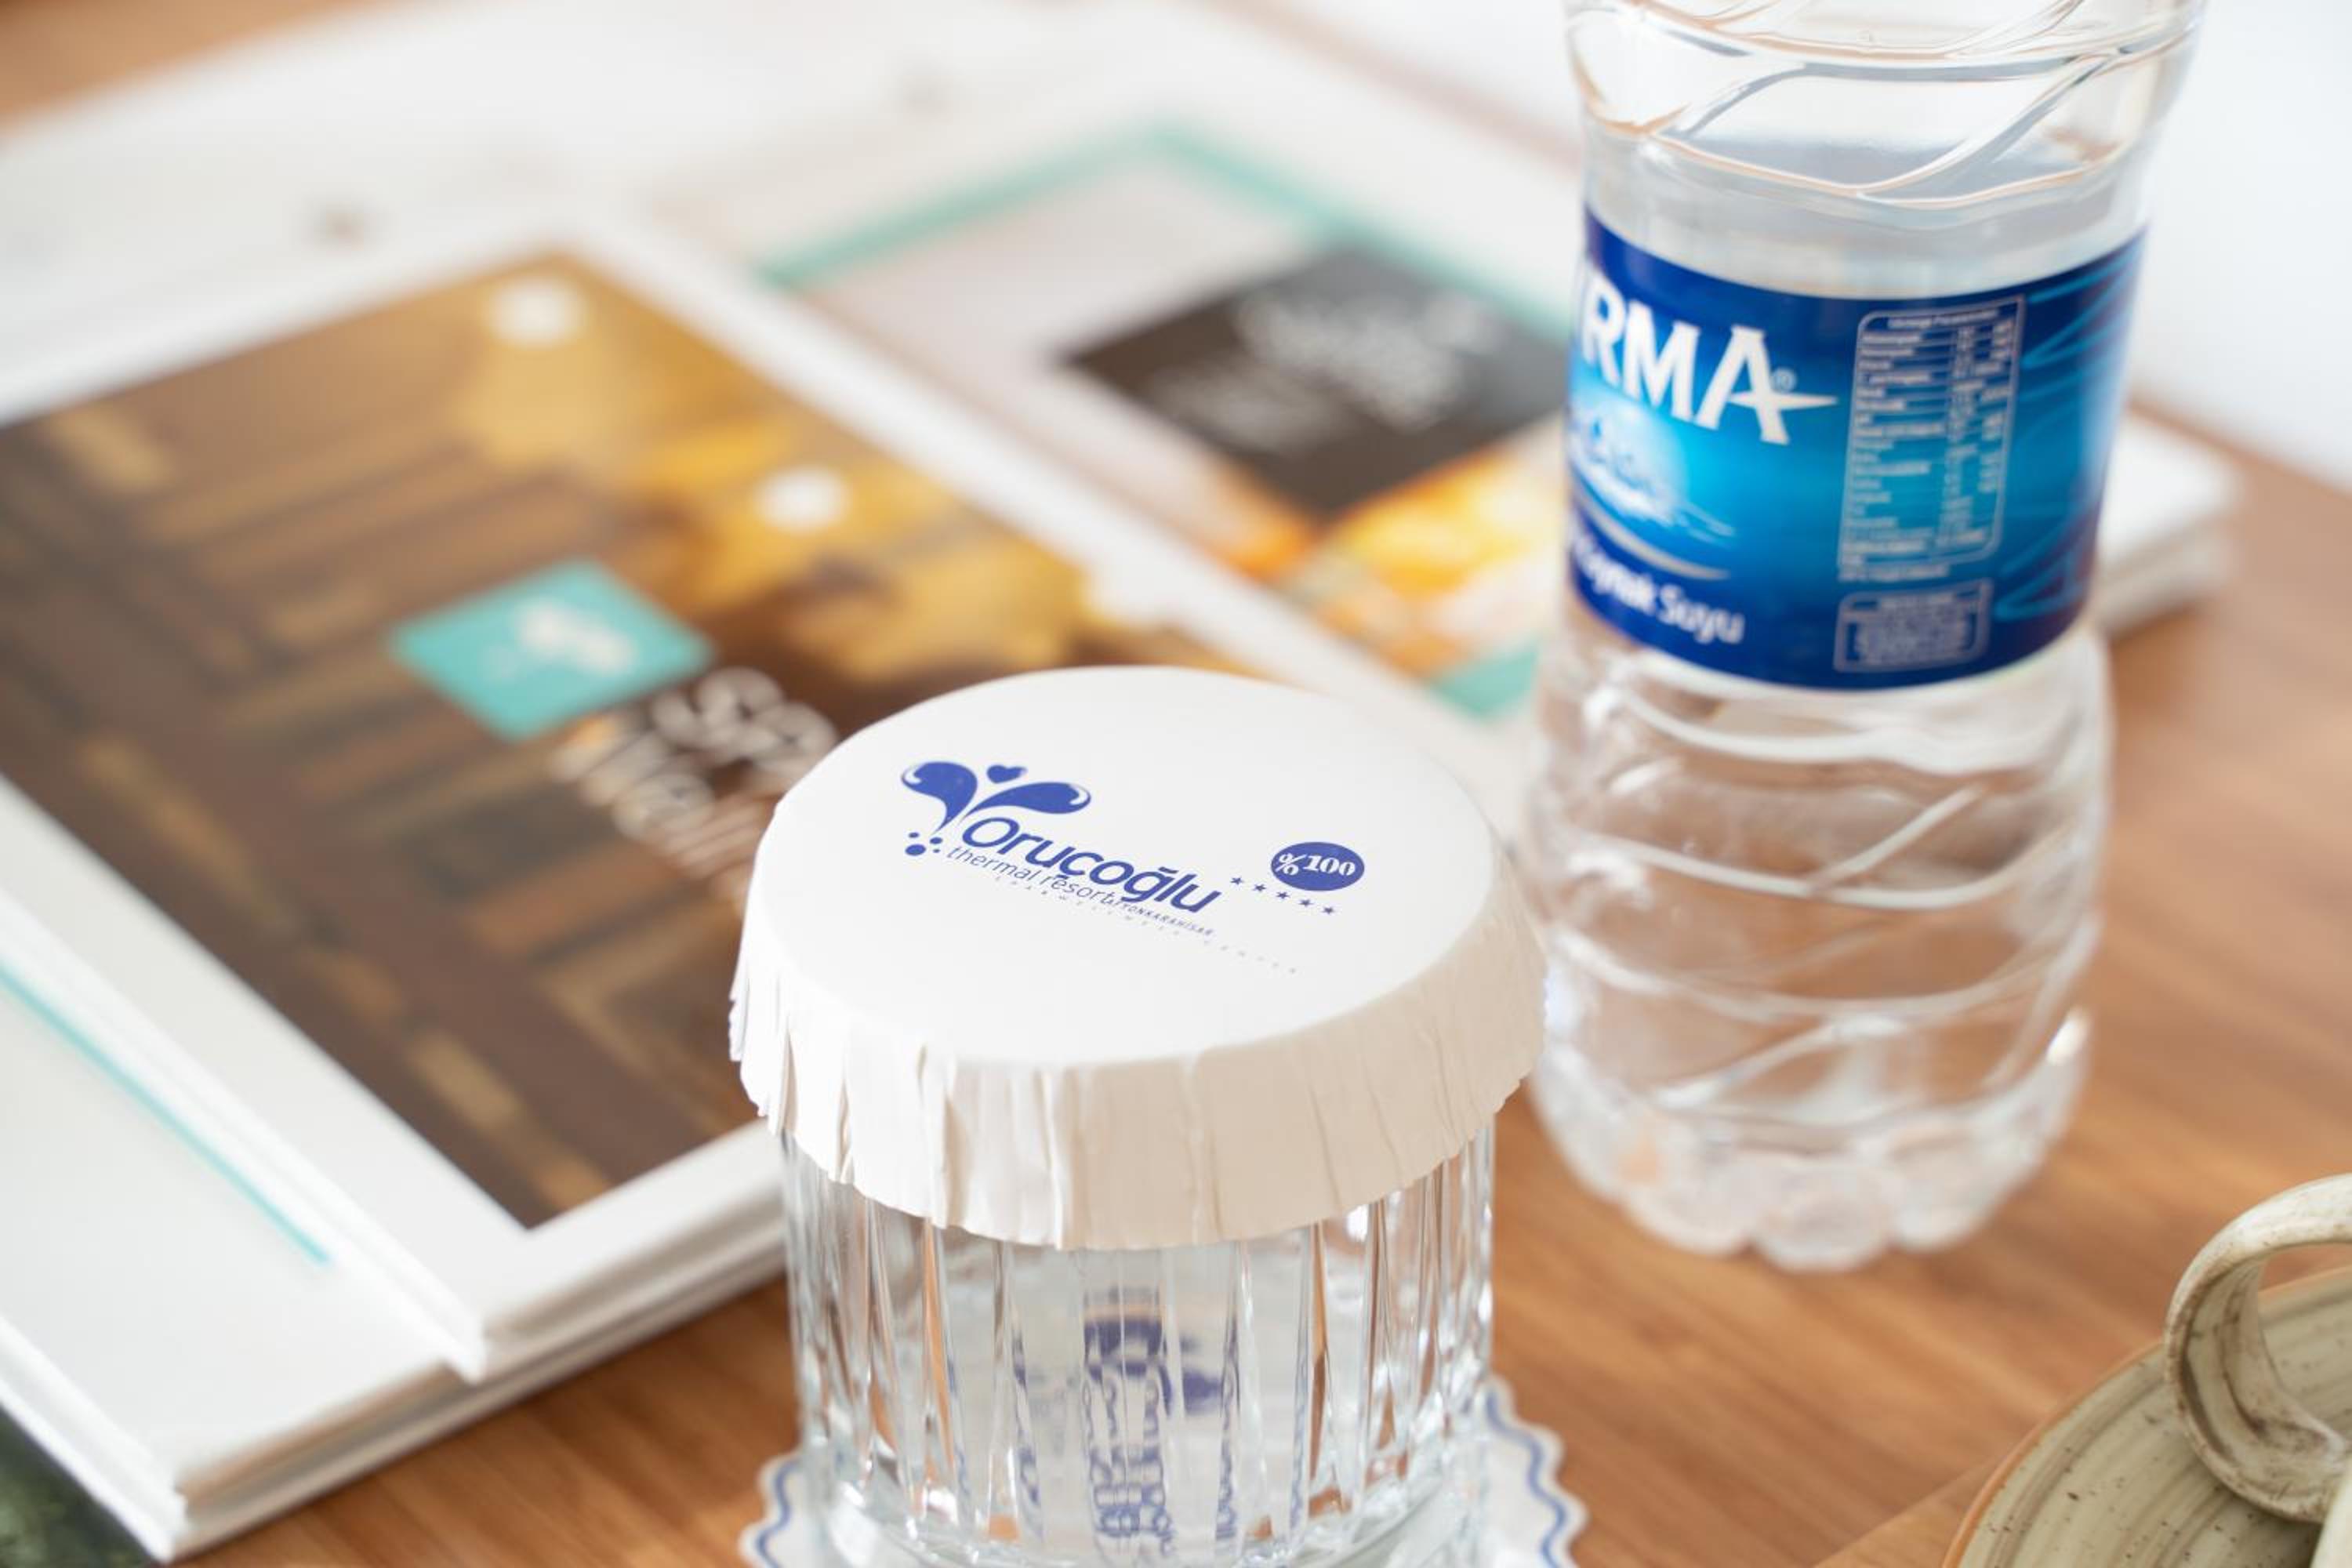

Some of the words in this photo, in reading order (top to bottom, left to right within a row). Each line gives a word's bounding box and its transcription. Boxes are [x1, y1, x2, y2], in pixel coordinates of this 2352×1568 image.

[1581, 268, 1839, 445] RMA
[1657, 583, 1745, 644] Suyu
[946, 846, 1043, 882] thermal
[1039, 874, 1116, 905] resort
[962, 816, 1222, 913] Oruçoğlu
[1275, 852, 1356, 877] %100
